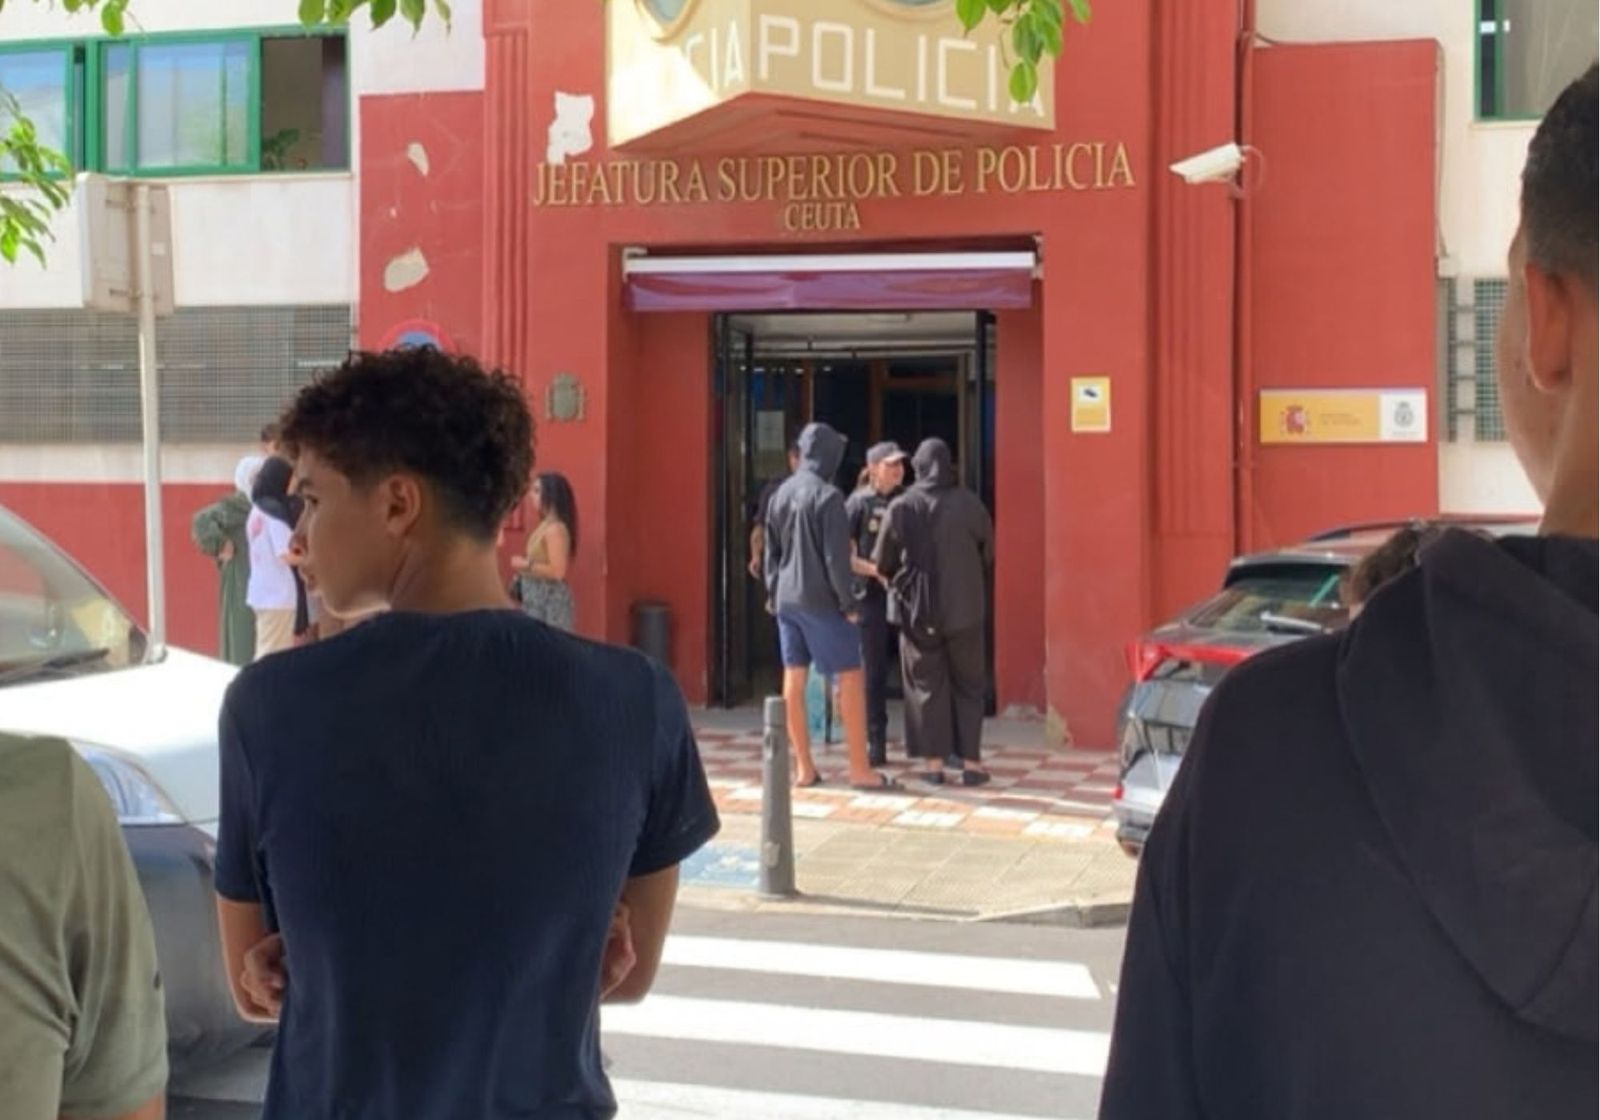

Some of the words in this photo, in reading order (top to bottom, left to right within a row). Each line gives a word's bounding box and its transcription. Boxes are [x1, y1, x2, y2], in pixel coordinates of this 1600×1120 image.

[533, 159, 709, 207] JEFATURA
[716, 152, 902, 202] SUPERIOR
[913, 149, 964, 196] DE
[975, 142, 1136, 194] POLICIA
[784, 202, 861, 231] CEUTA
